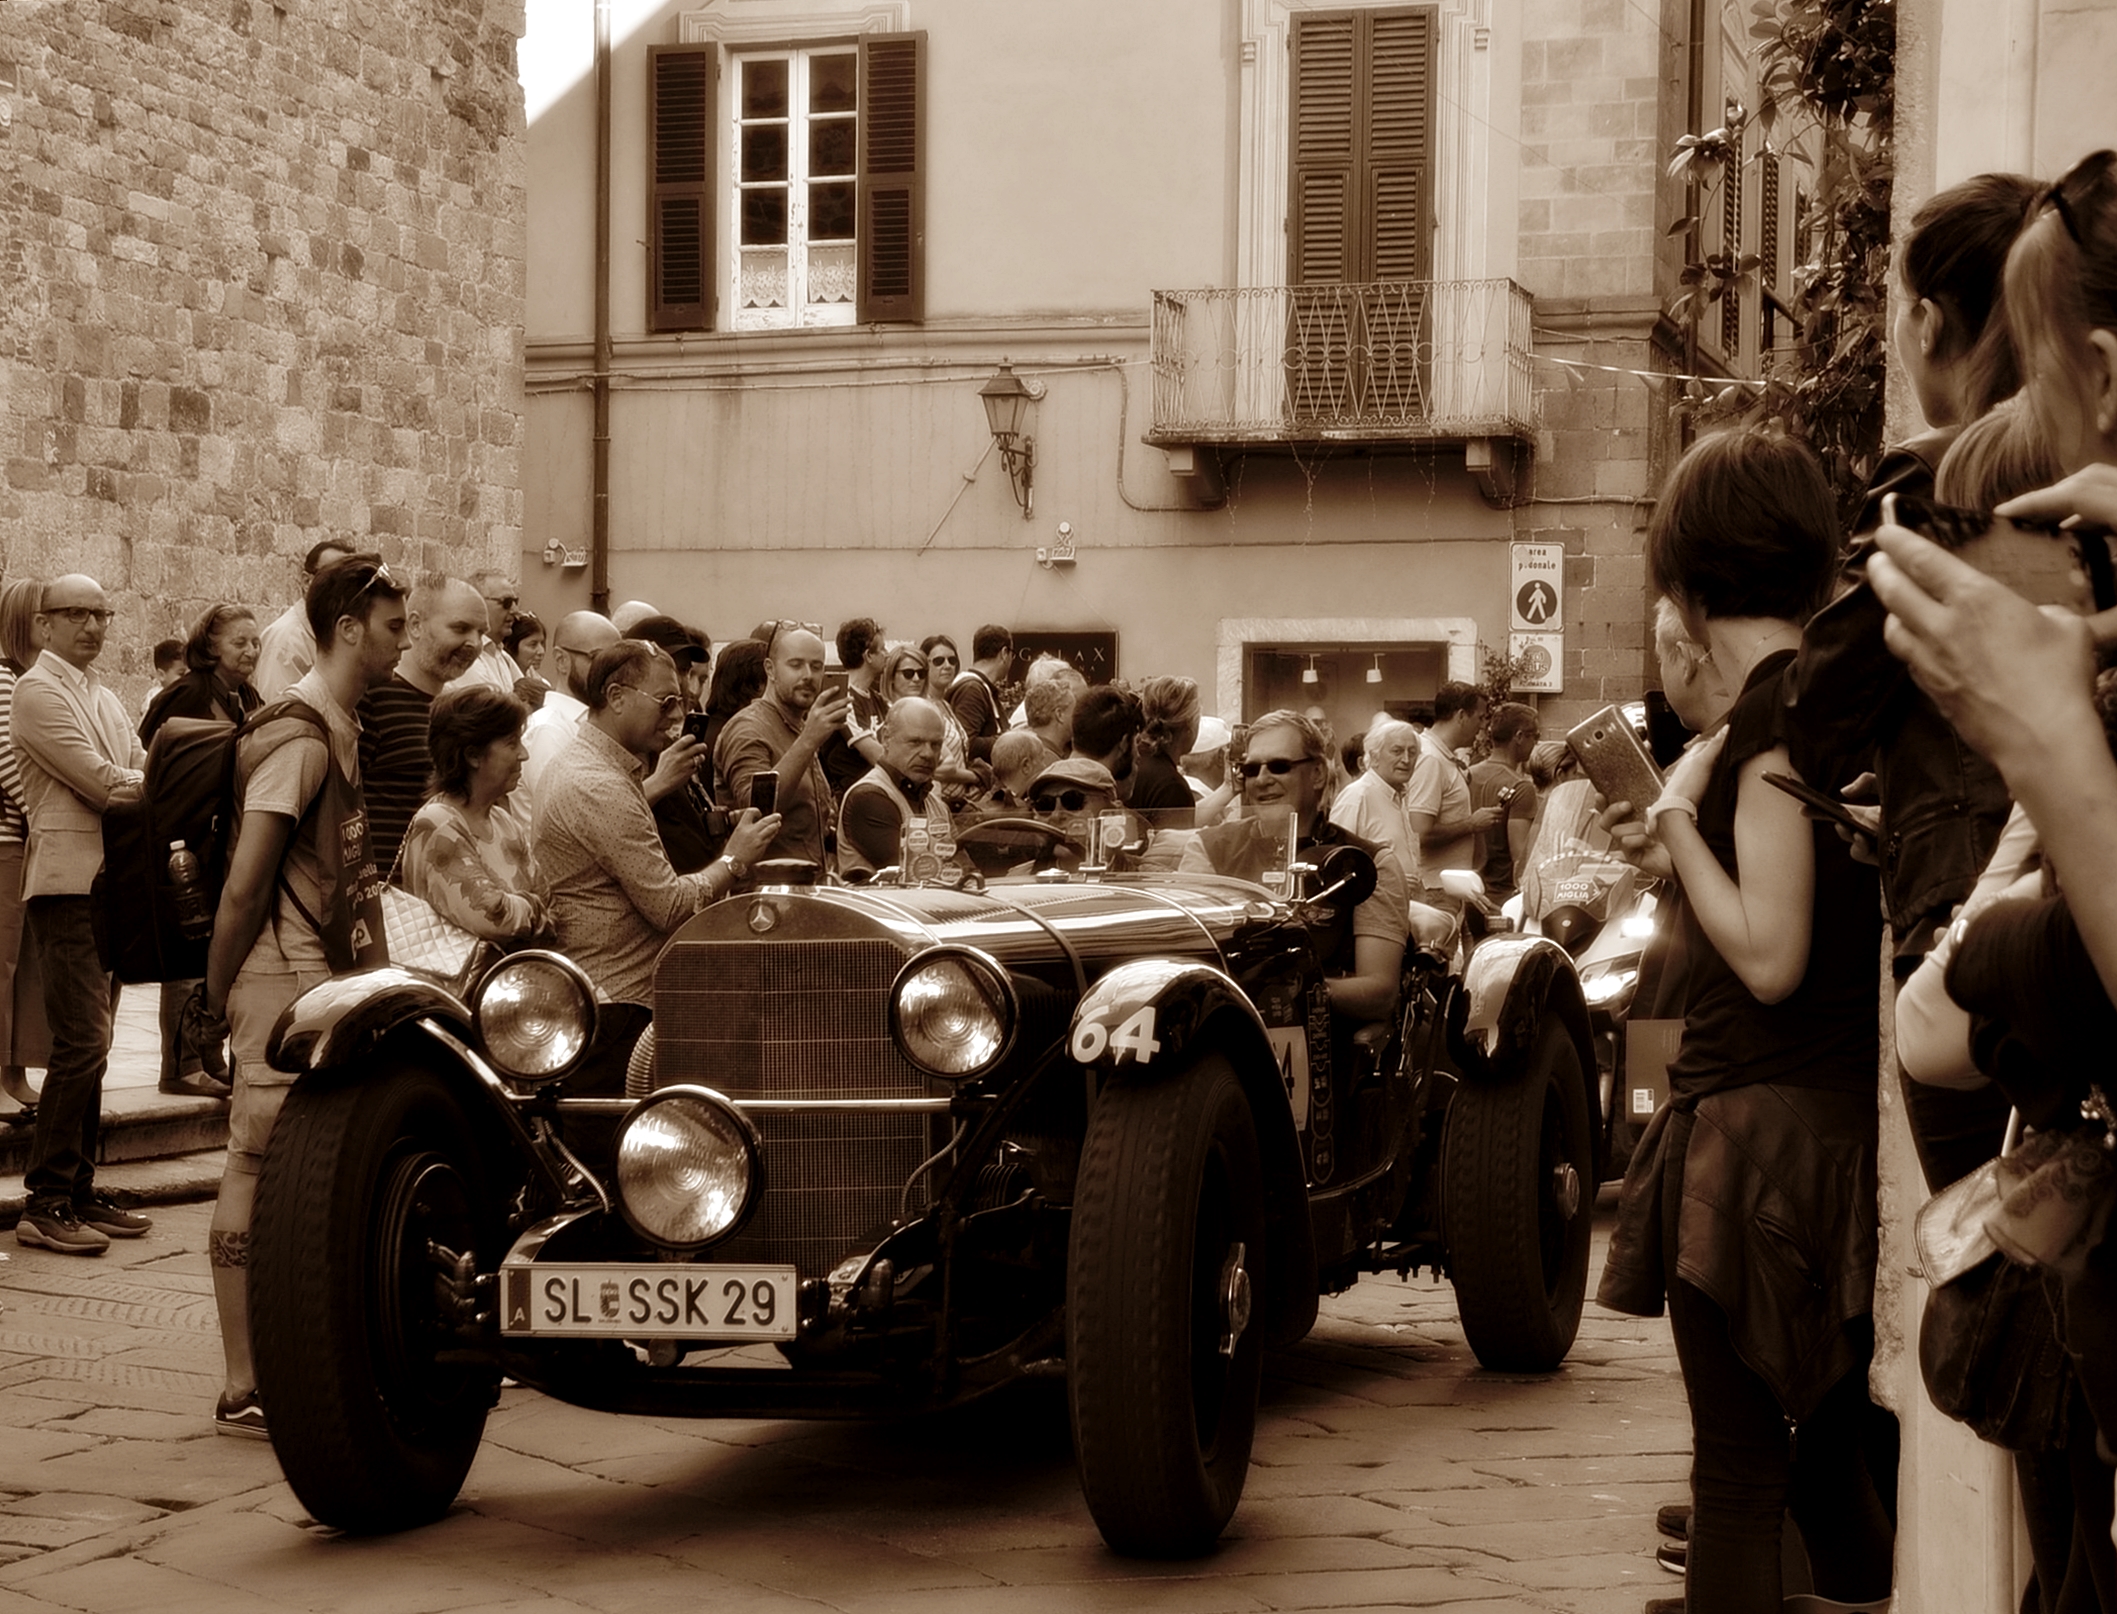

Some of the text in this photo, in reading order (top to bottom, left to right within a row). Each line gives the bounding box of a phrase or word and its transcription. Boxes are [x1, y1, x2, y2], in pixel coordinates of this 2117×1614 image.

[1529, 548, 1547, 556] area
[1518, 560, 1557, 571] pdonale
[1557, 891, 1589, 899] MIGLIA
[1071, 1004, 1161, 1064] 64
[512, 1276, 776, 1326] A SL SSK 29
